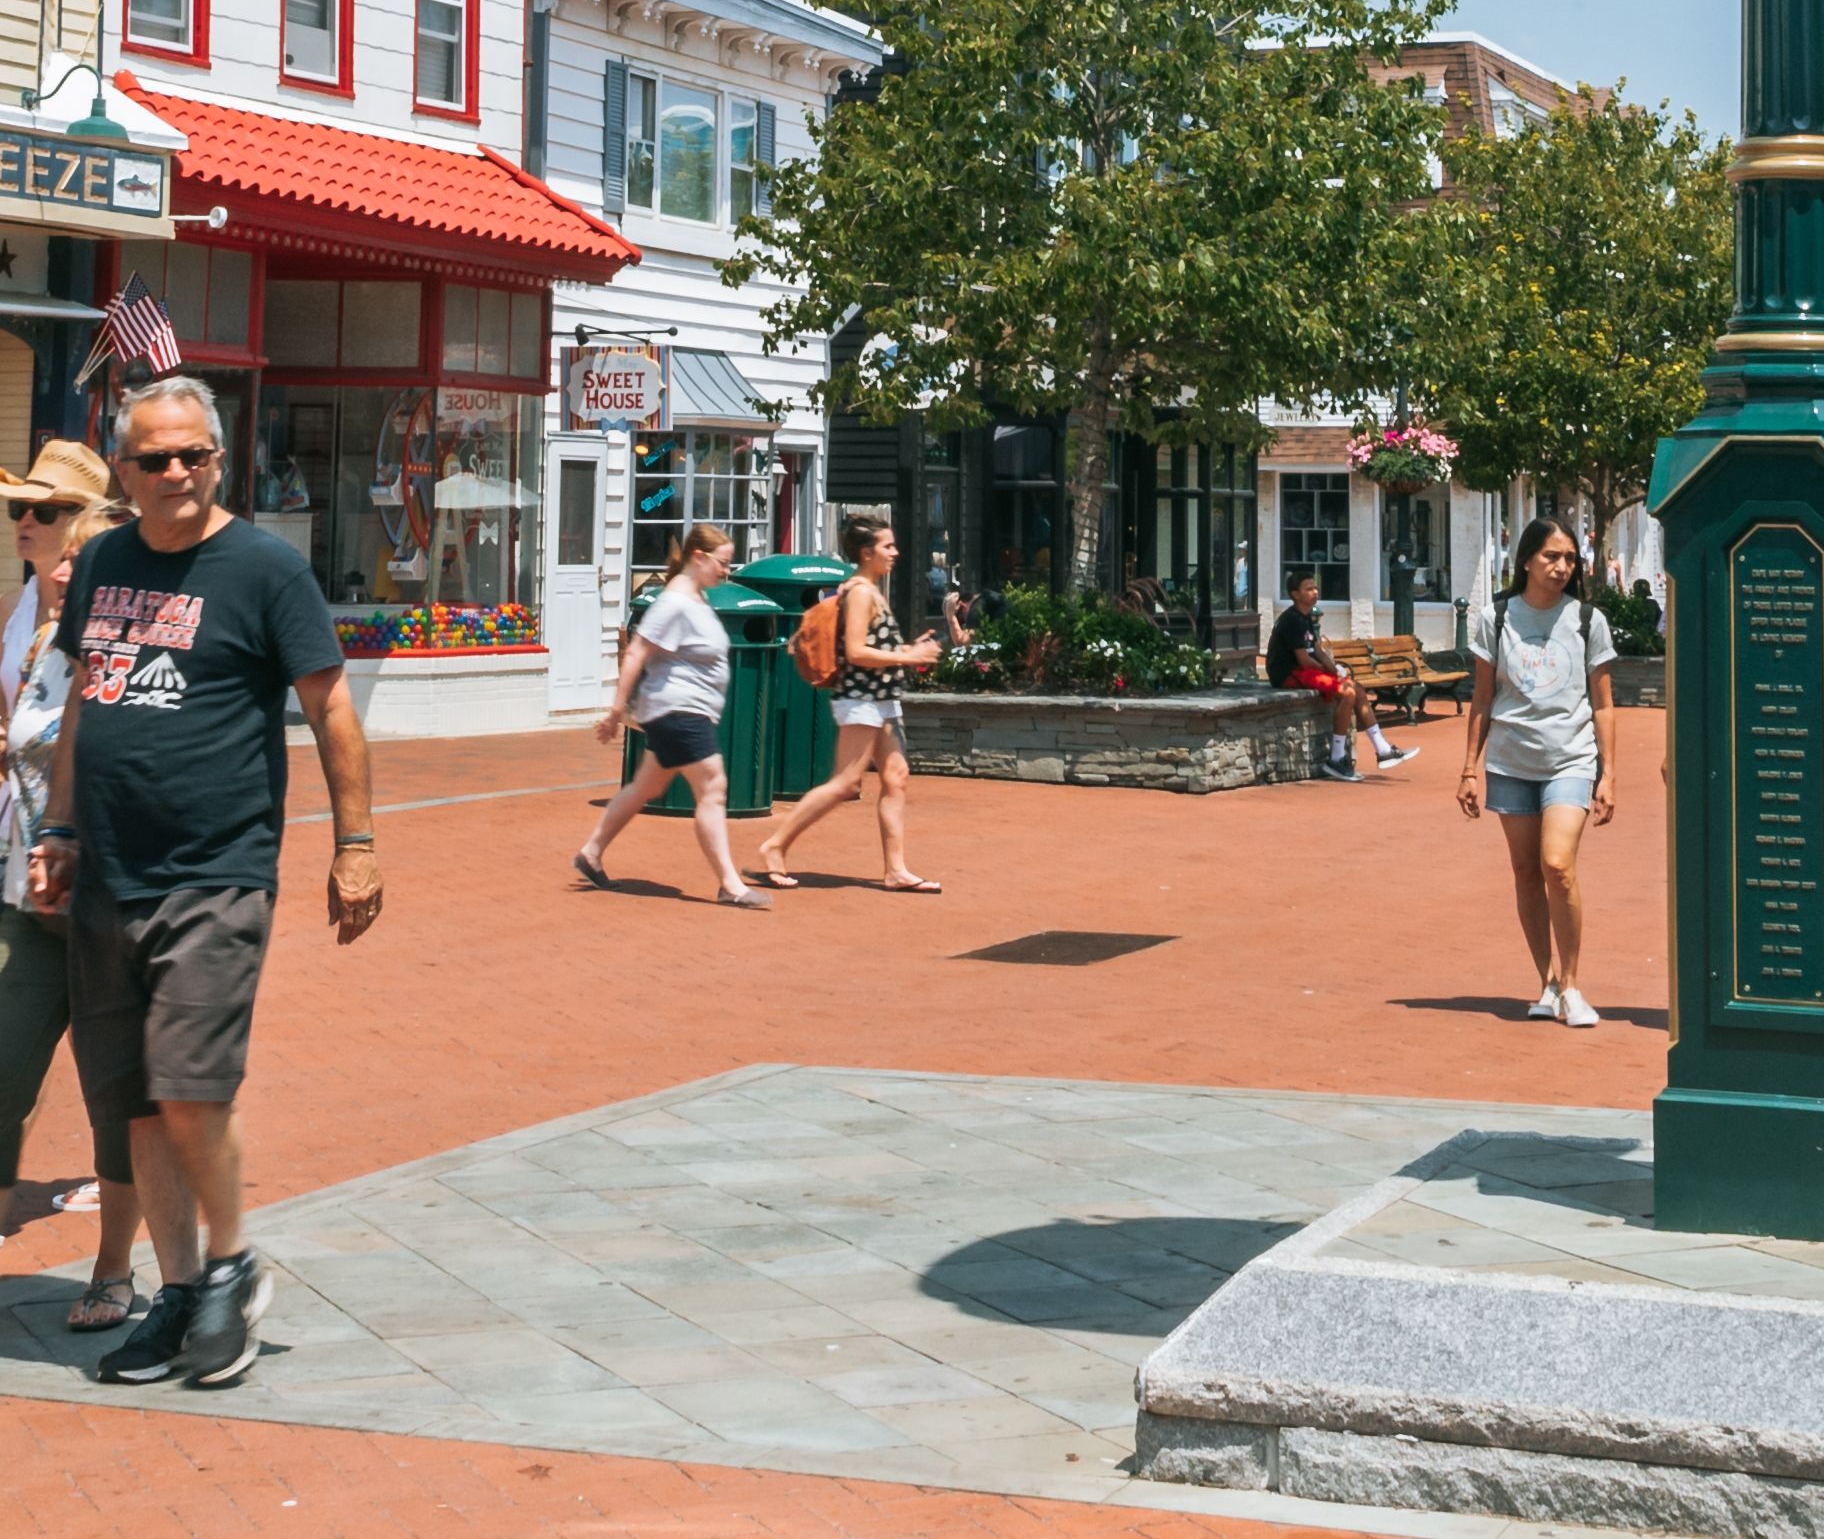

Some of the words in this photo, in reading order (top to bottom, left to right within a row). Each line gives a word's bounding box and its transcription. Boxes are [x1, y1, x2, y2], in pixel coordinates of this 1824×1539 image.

[582, 369, 645, 389] SWEET
[585, 390, 644, 409] HOUSE
[469, 454, 503, 479] SWEE
[90, 586, 204, 627] SARATOGA
